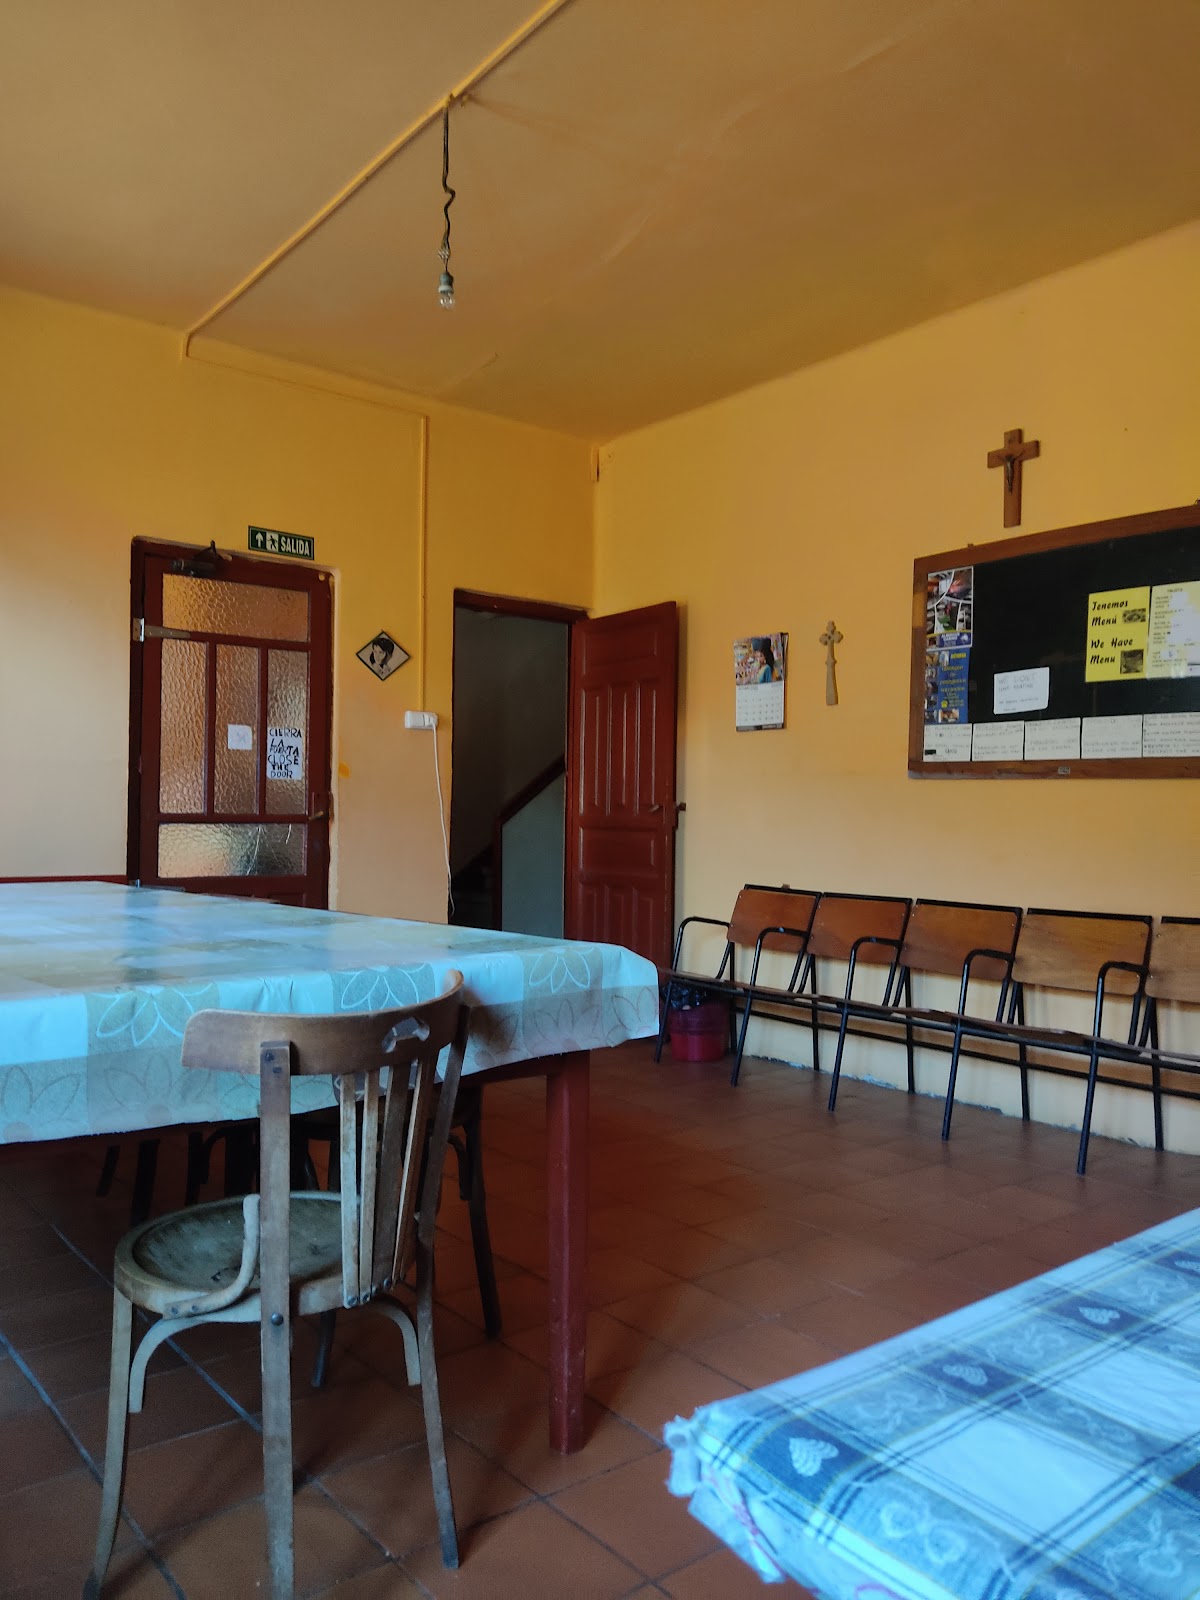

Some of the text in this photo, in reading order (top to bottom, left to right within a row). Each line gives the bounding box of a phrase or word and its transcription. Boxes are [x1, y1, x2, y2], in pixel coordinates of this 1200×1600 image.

[280, 536, 310, 556] SALIDA
[1092, 600, 1128, 611] Tenemos
[1091, 637, 1133, 649] We Have
[1090, 654, 1115, 664] Menu
[269, 727, 302, 738] CIERRA
[271, 738, 284, 748] LA
[268, 754, 299, 766] CLOSE
[271, 763, 289, 771] THE
[271, 770, 293, 779] DOOR
